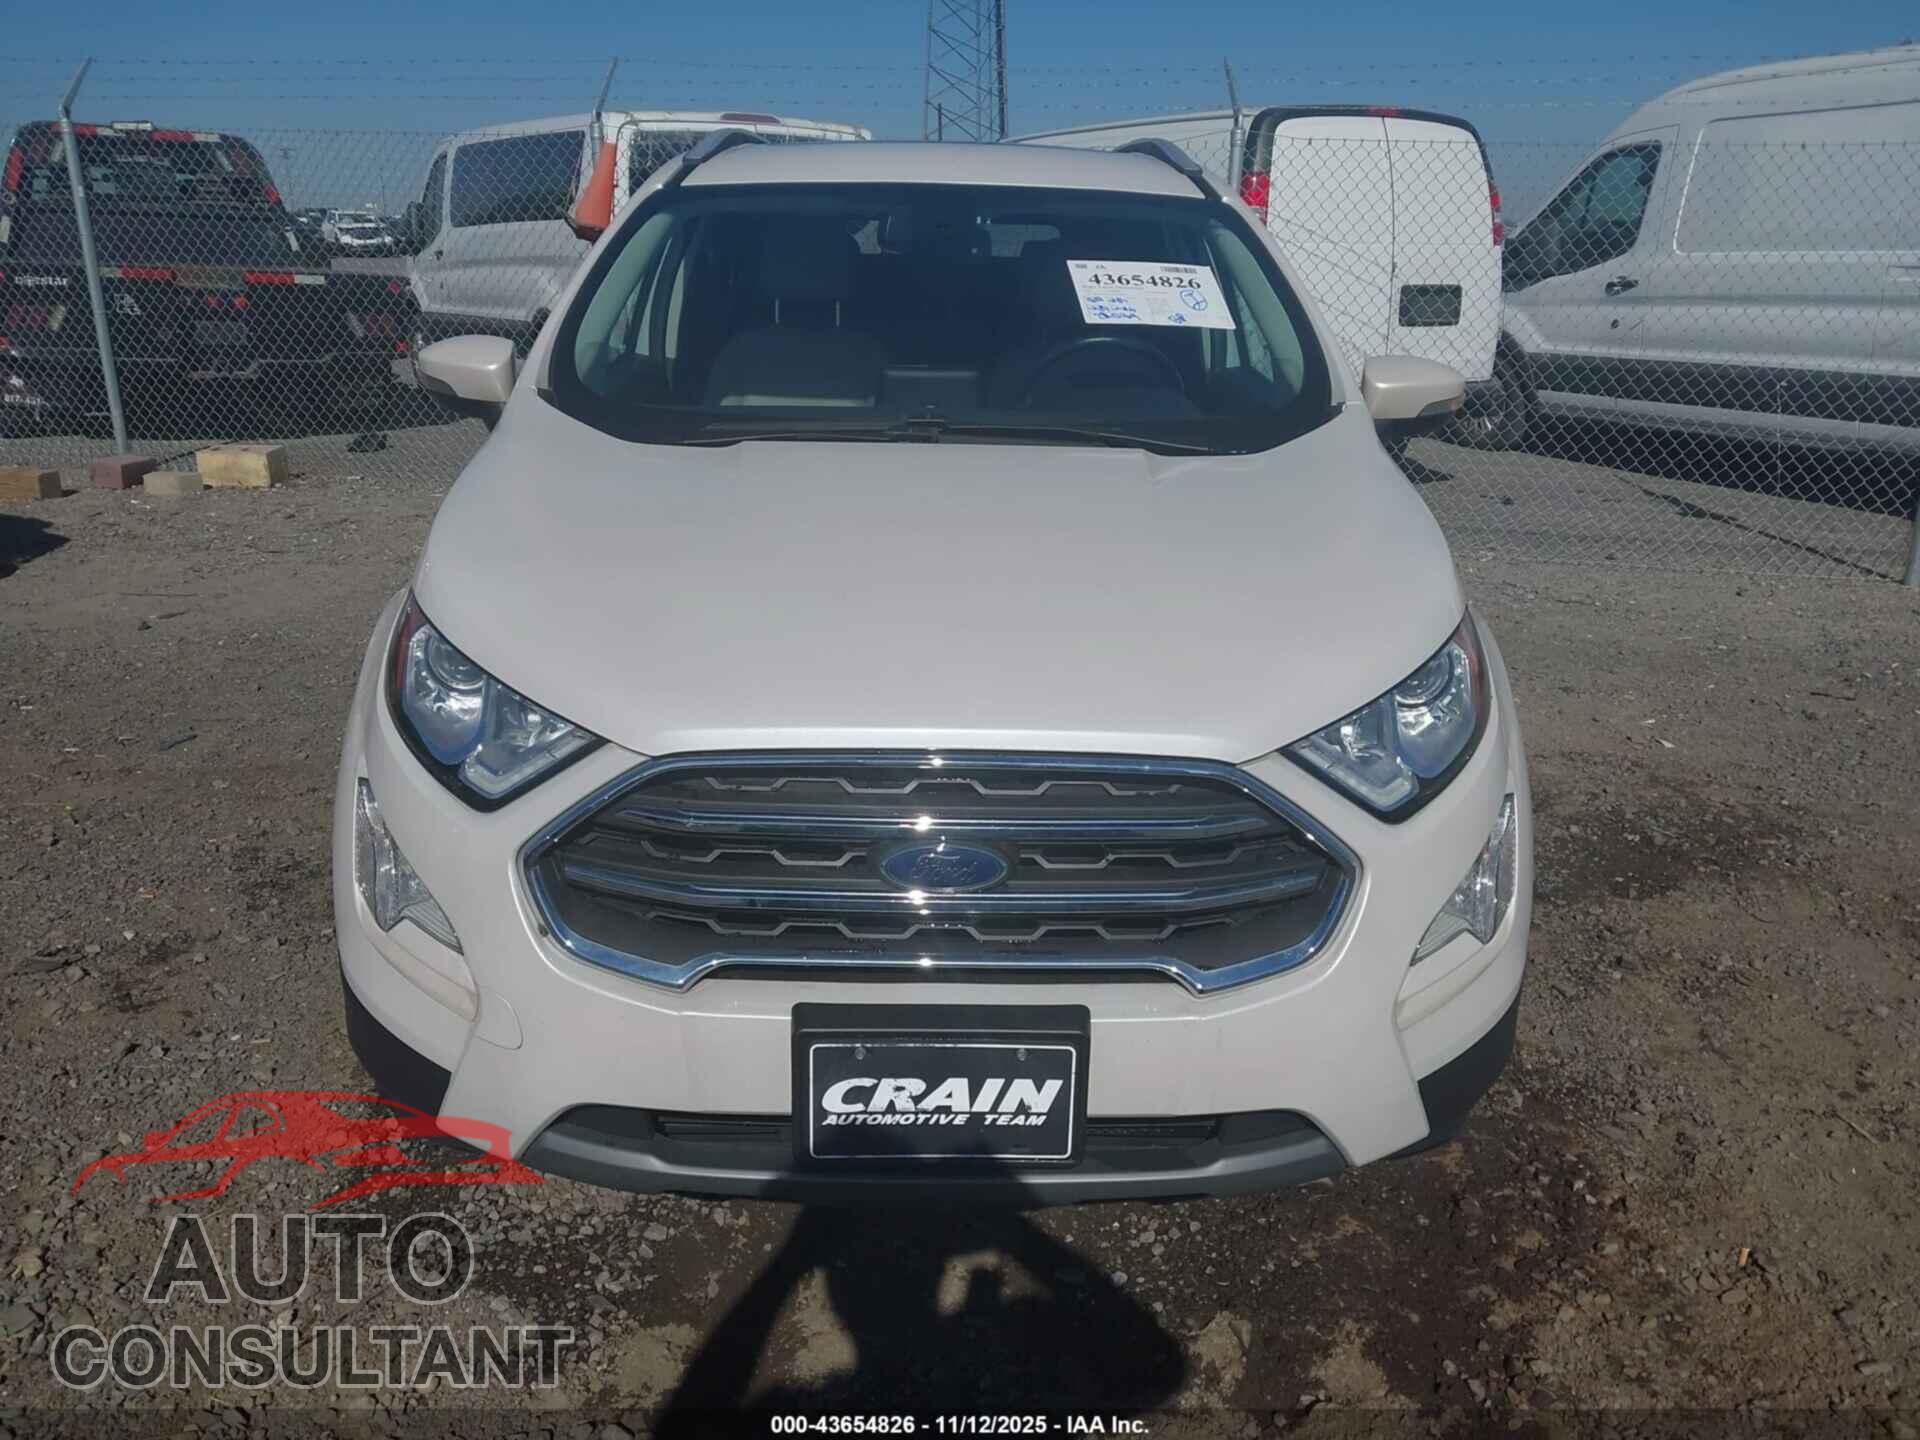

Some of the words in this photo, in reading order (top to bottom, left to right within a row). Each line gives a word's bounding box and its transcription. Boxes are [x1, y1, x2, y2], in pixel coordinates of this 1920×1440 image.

[1088, 273, 1202, 289] 43654826
[821, 1077, 1064, 1113] CRAIN
[821, 1113, 971, 1126] AUTOMOTIVE
[983, 1114, 1048, 1127] TEAM
